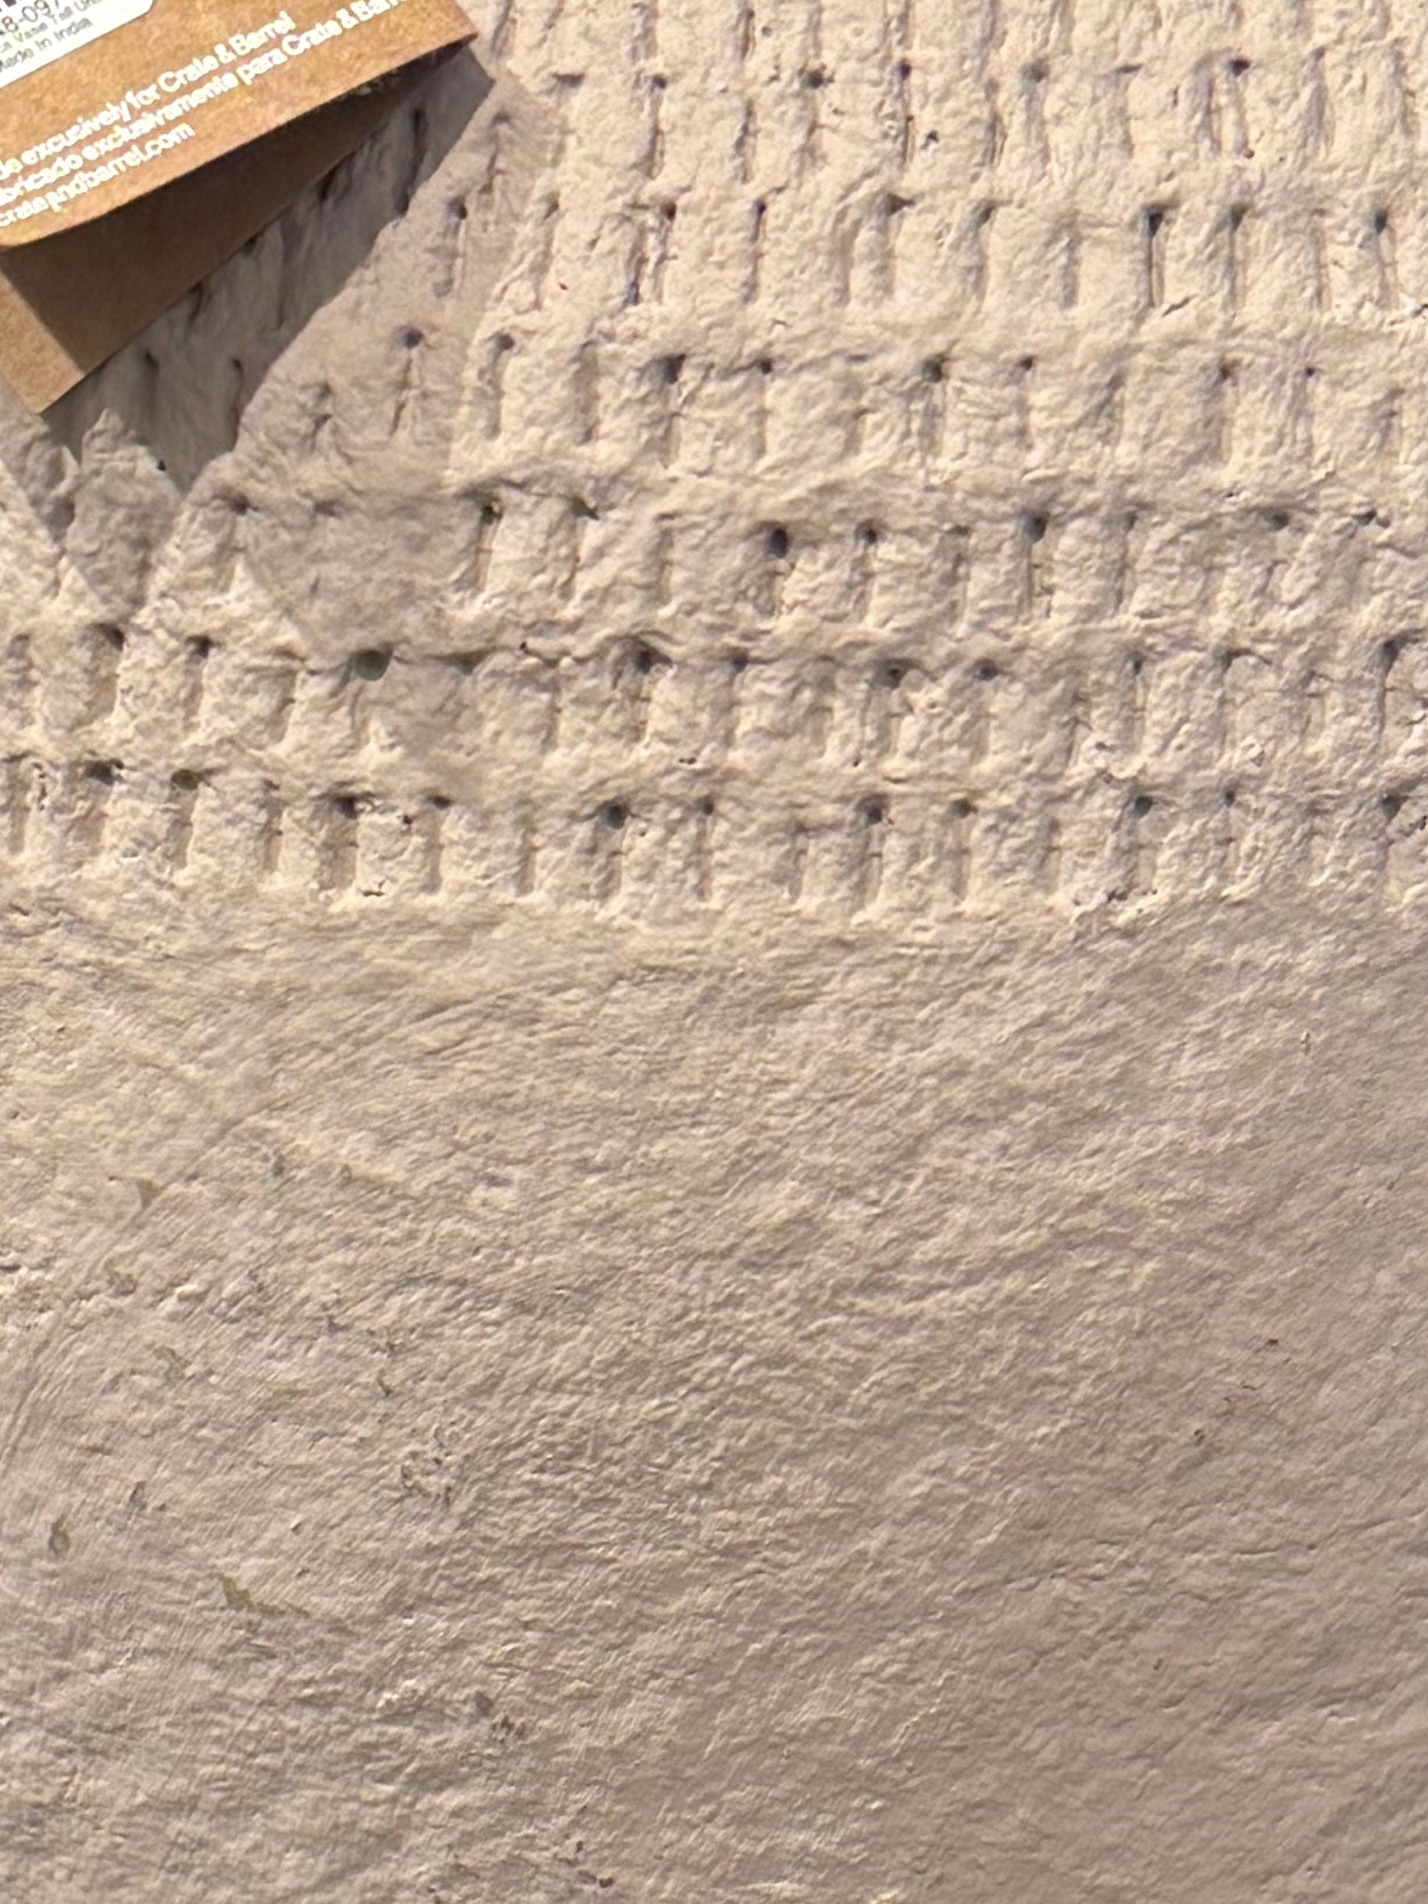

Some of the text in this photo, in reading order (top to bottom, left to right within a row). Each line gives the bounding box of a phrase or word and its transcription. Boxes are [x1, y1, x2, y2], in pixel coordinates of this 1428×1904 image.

[53, 16, 93, 42] India
[125, 84, 160, 108] for
[158, 56, 219, 92] Crate
[214, 44, 236, 63] &
[228, 11, 295, 55] Barrel
[81, 72, 238, 160] exclusivamente
[237, 48, 287, 85] para
[282, 20, 342, 55] Crate
[336, 9, 358, 28] &
